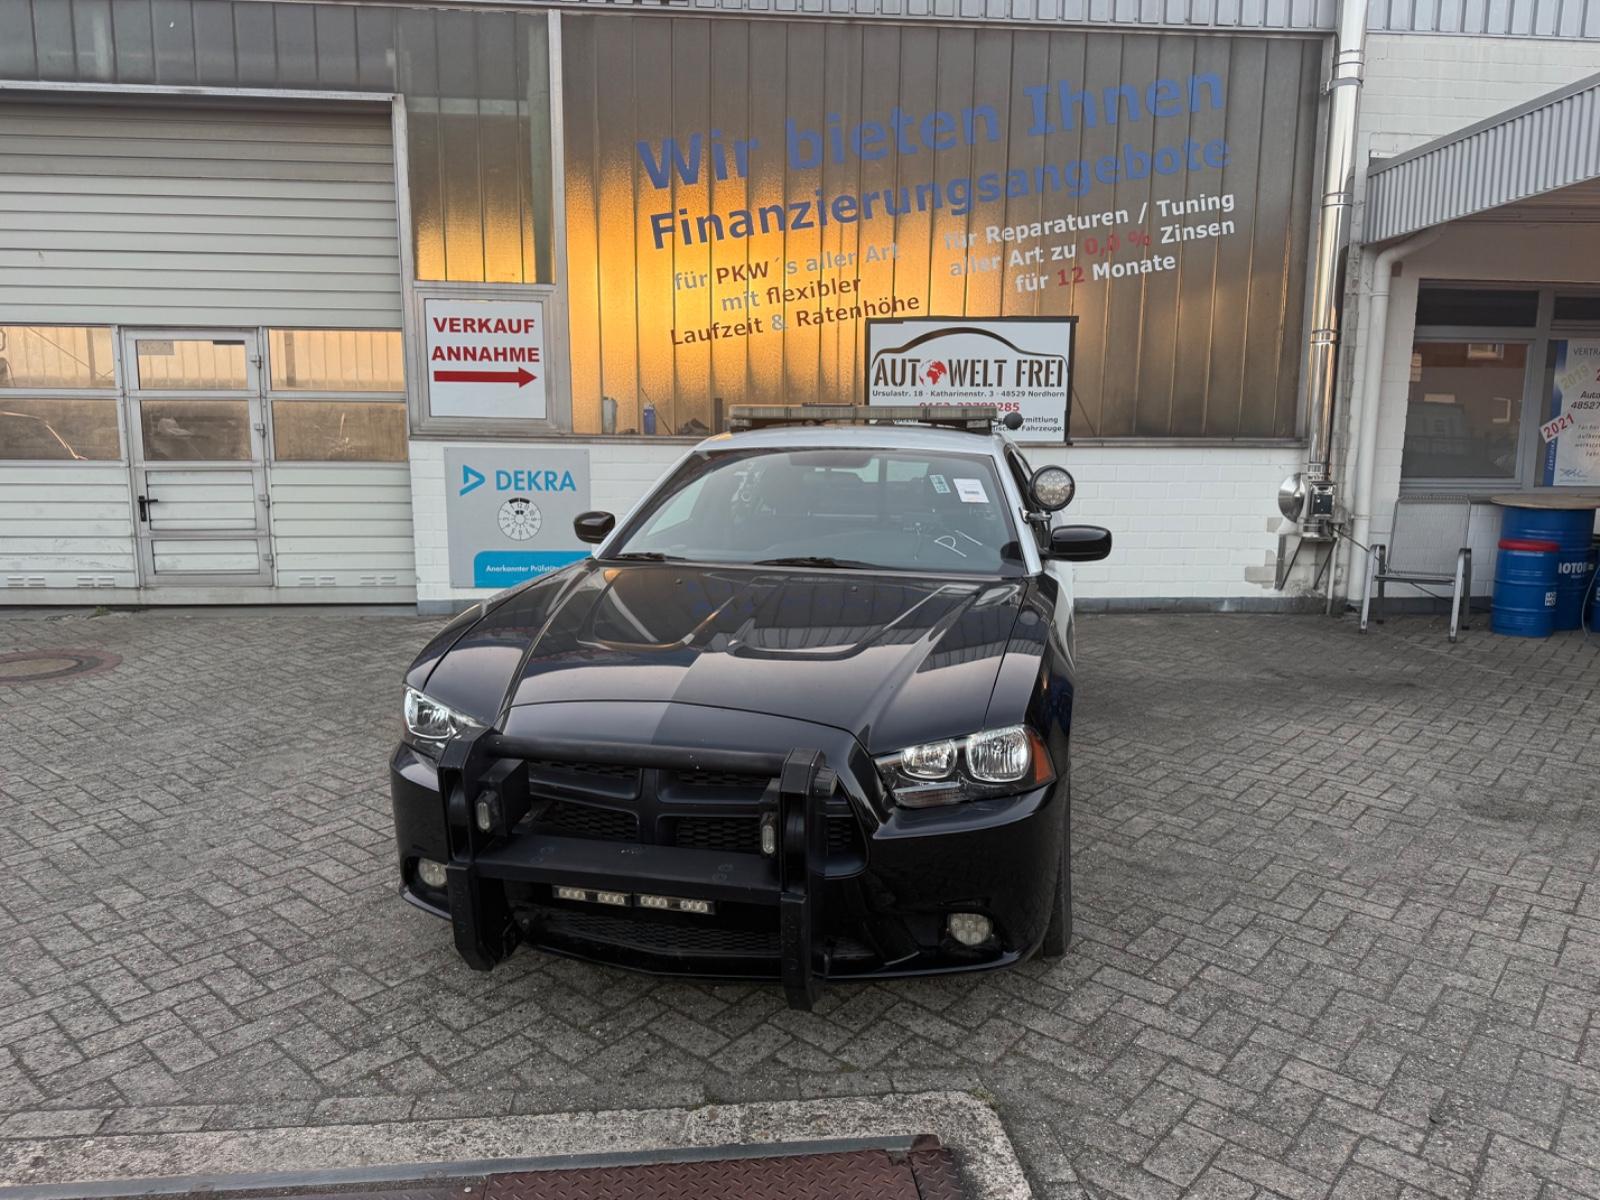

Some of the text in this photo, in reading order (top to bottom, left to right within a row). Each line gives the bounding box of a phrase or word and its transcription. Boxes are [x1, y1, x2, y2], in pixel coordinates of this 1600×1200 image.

[635, 72, 1224, 190] Wir bieten Ihnen
[650, 134, 1232, 250] Finanzierungsangebote
[944, 194, 1235, 250] für Reparaturen / Tuning
[674, 270, 708, 290] für
[806, 250, 857, 272] aller
[865, 243, 901, 264] Art
[950, 254, 1000, 277] aller
[1009, 246, 1044, 268] Art
[1051, 244, 1077, 261] zu
[1128, 230, 1151, 248] %
[1160, 220, 1235, 245] Zinsen
[1015, 255, 1176, 293] für 12 Monate
[722, 277, 862, 312] mit flexibler
[432, 317, 536, 334] VERKAUF
[670, 296, 920, 345] Laufzeit & Ratenhöhe
[431, 346, 541, 362] ANNAHME
[1015, 359, 1063, 388] FREI
[1543, 413, 1574, 438] 2021
[495, 470, 577, 492] DEKRA
[486, 564, 529, 572] Anerkannter
